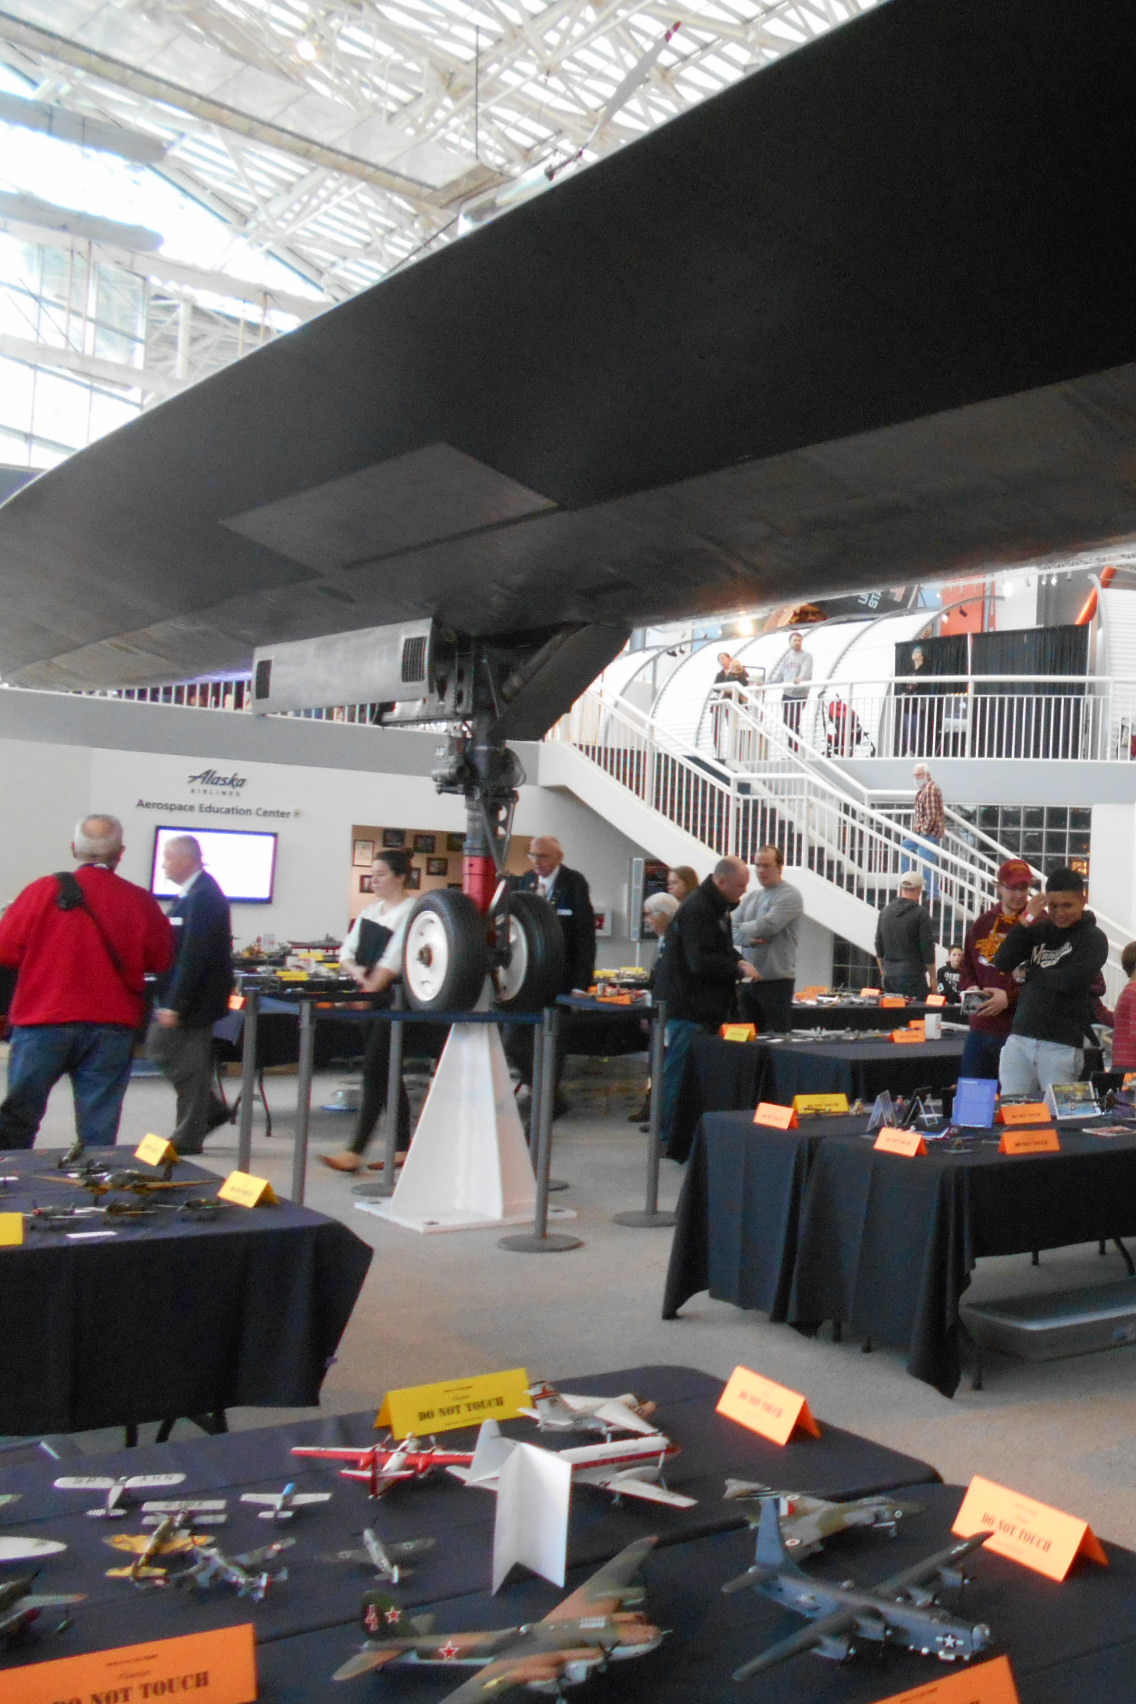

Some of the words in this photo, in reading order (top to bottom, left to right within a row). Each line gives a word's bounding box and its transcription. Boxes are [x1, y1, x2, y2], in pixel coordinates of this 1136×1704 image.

[187, 768, 247, 789] Alaska
[190, 788, 241, 797] AIRLINES
[136, 799, 195, 813] Aerospace
[199, 803, 252, 817] Education
[255, 807, 291, 818] Center
[418, 1410, 435, 1422] DO
[439, 1405, 462, 1417] NOT
[466, 1396, 504, 1412] TOUCH
[981, 1512, 995, 1527] DO
[997, 1519, 1017, 1535] NOT
[1018, 1529, 1053, 1553] TOUCH
[90, 1686, 133, 1704] NOT
[139, 1671, 210, 1699] TOUCH
